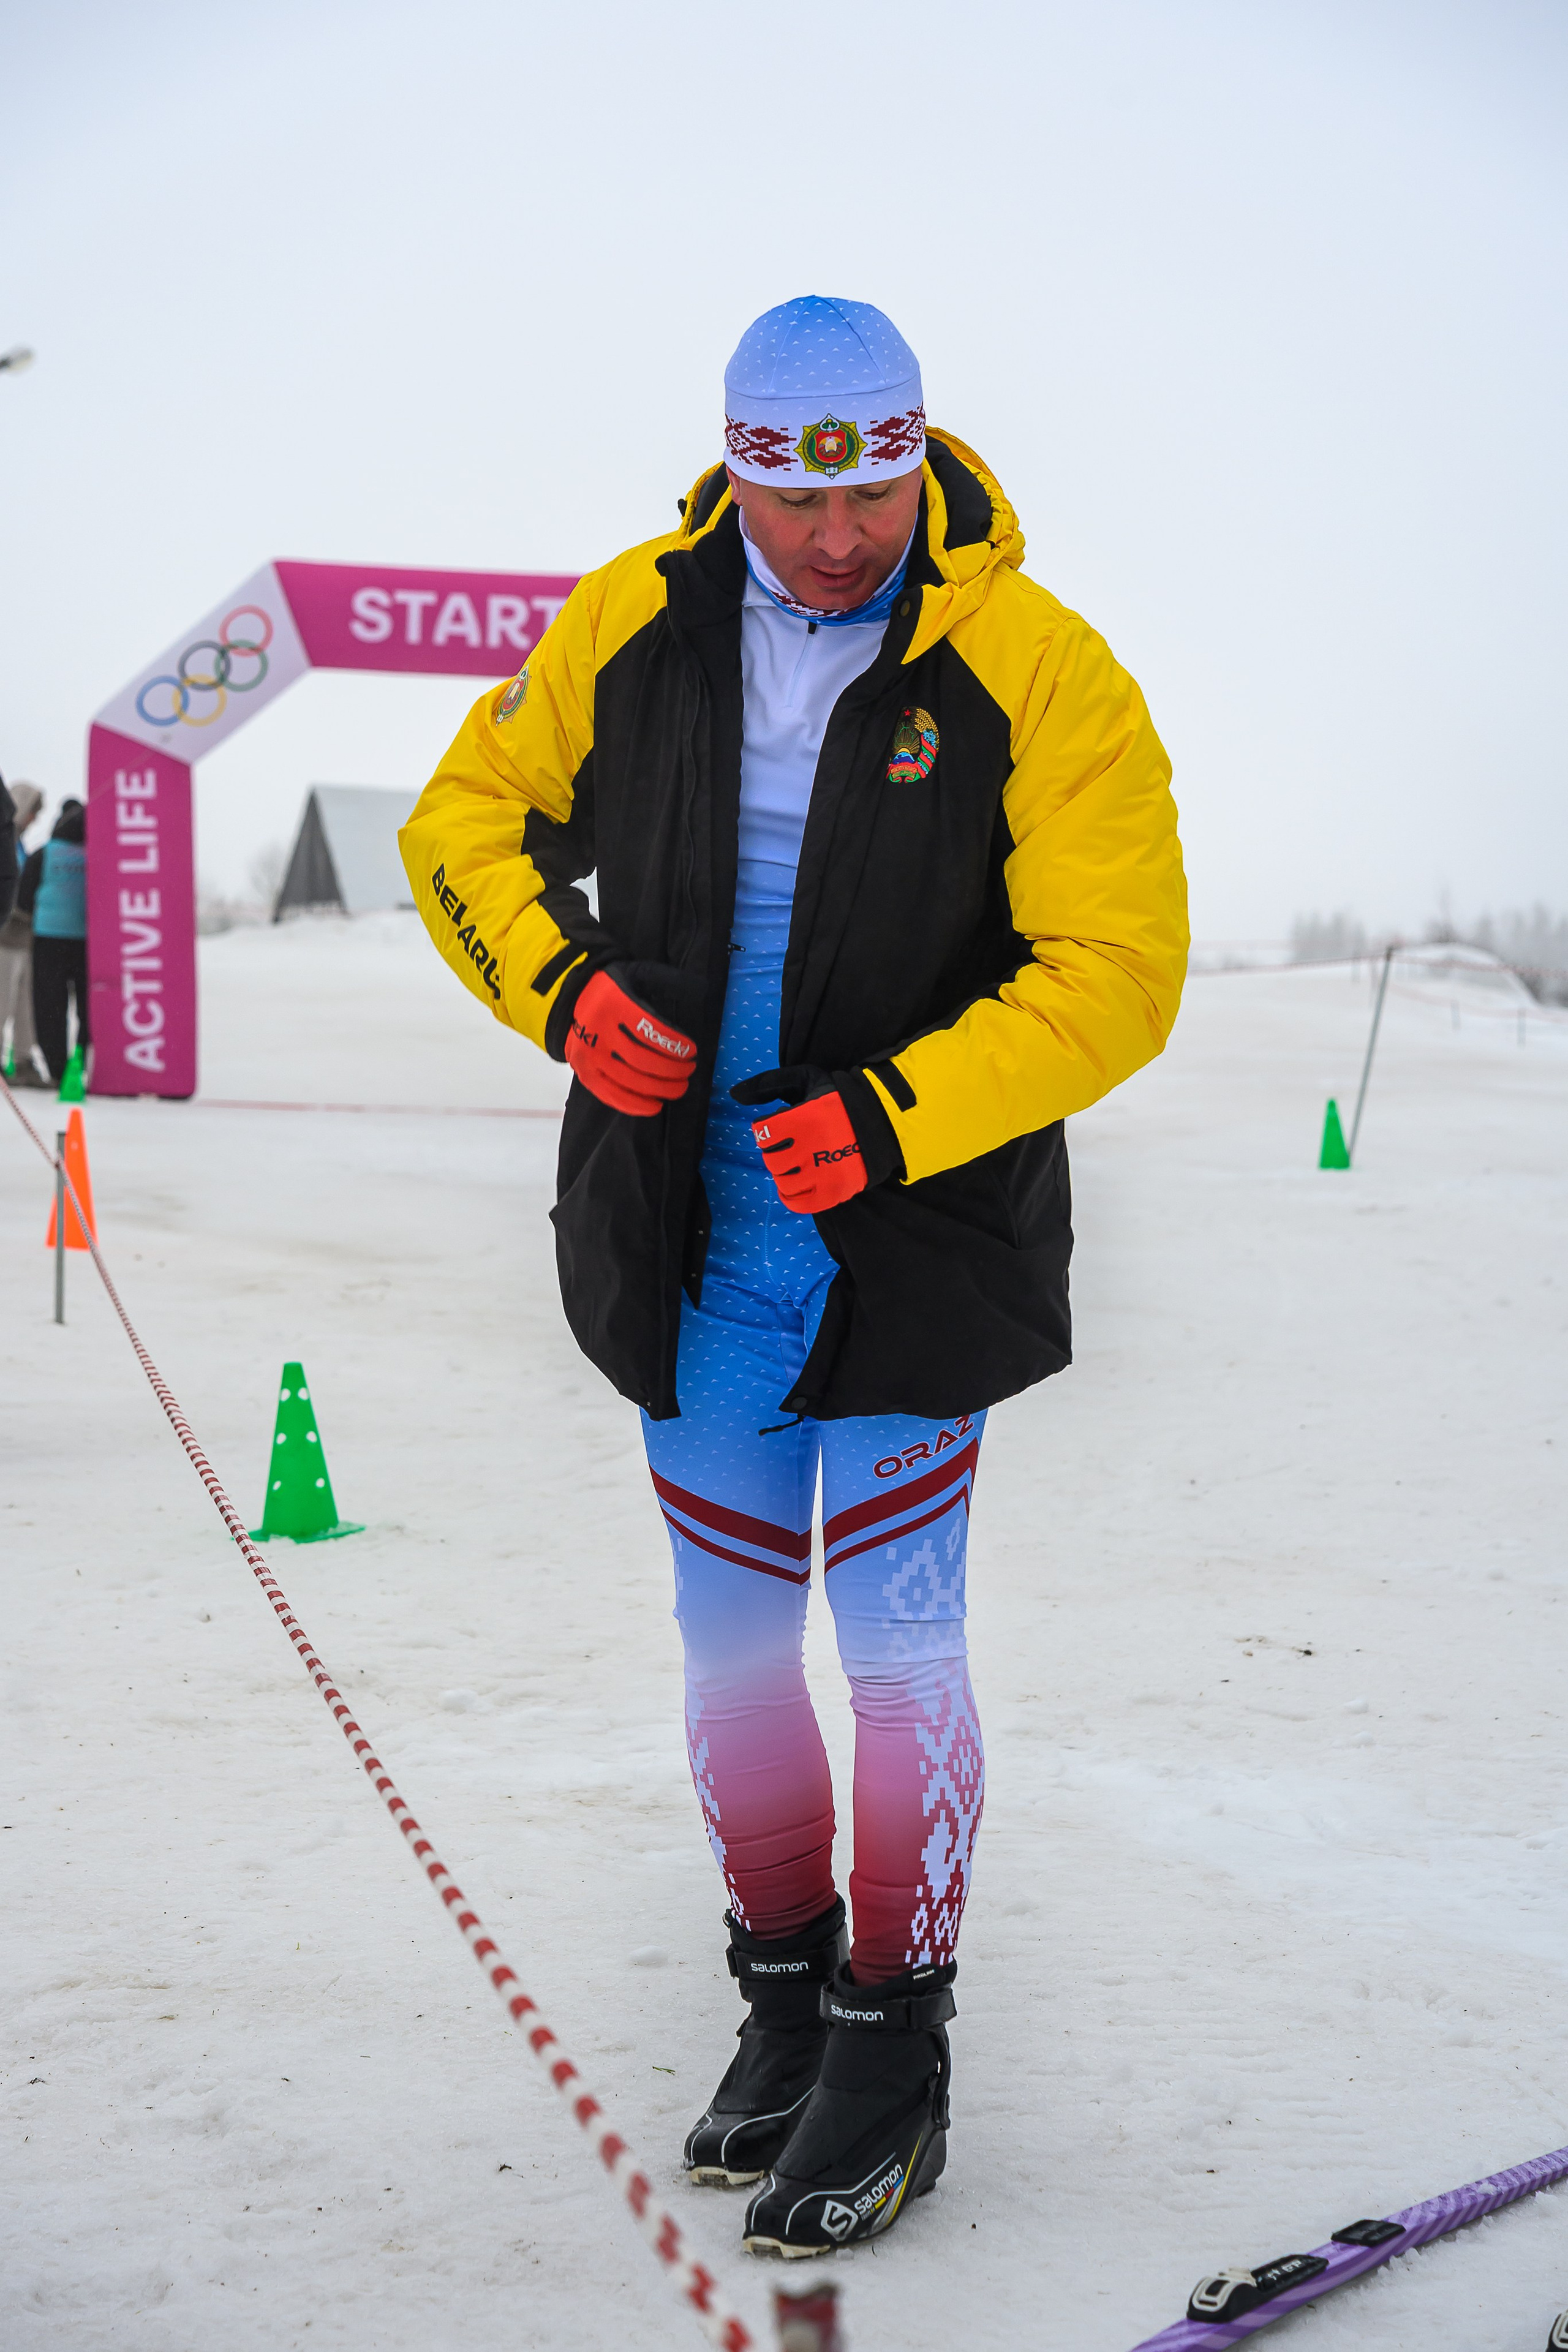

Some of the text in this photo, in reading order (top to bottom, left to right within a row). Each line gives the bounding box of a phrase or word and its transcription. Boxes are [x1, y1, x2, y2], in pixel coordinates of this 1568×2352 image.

[349, 586, 568, 650] START
[115, 767, 165, 1074] ACTIVE LIFE
[873, 1414, 974, 1480] ORAZ
